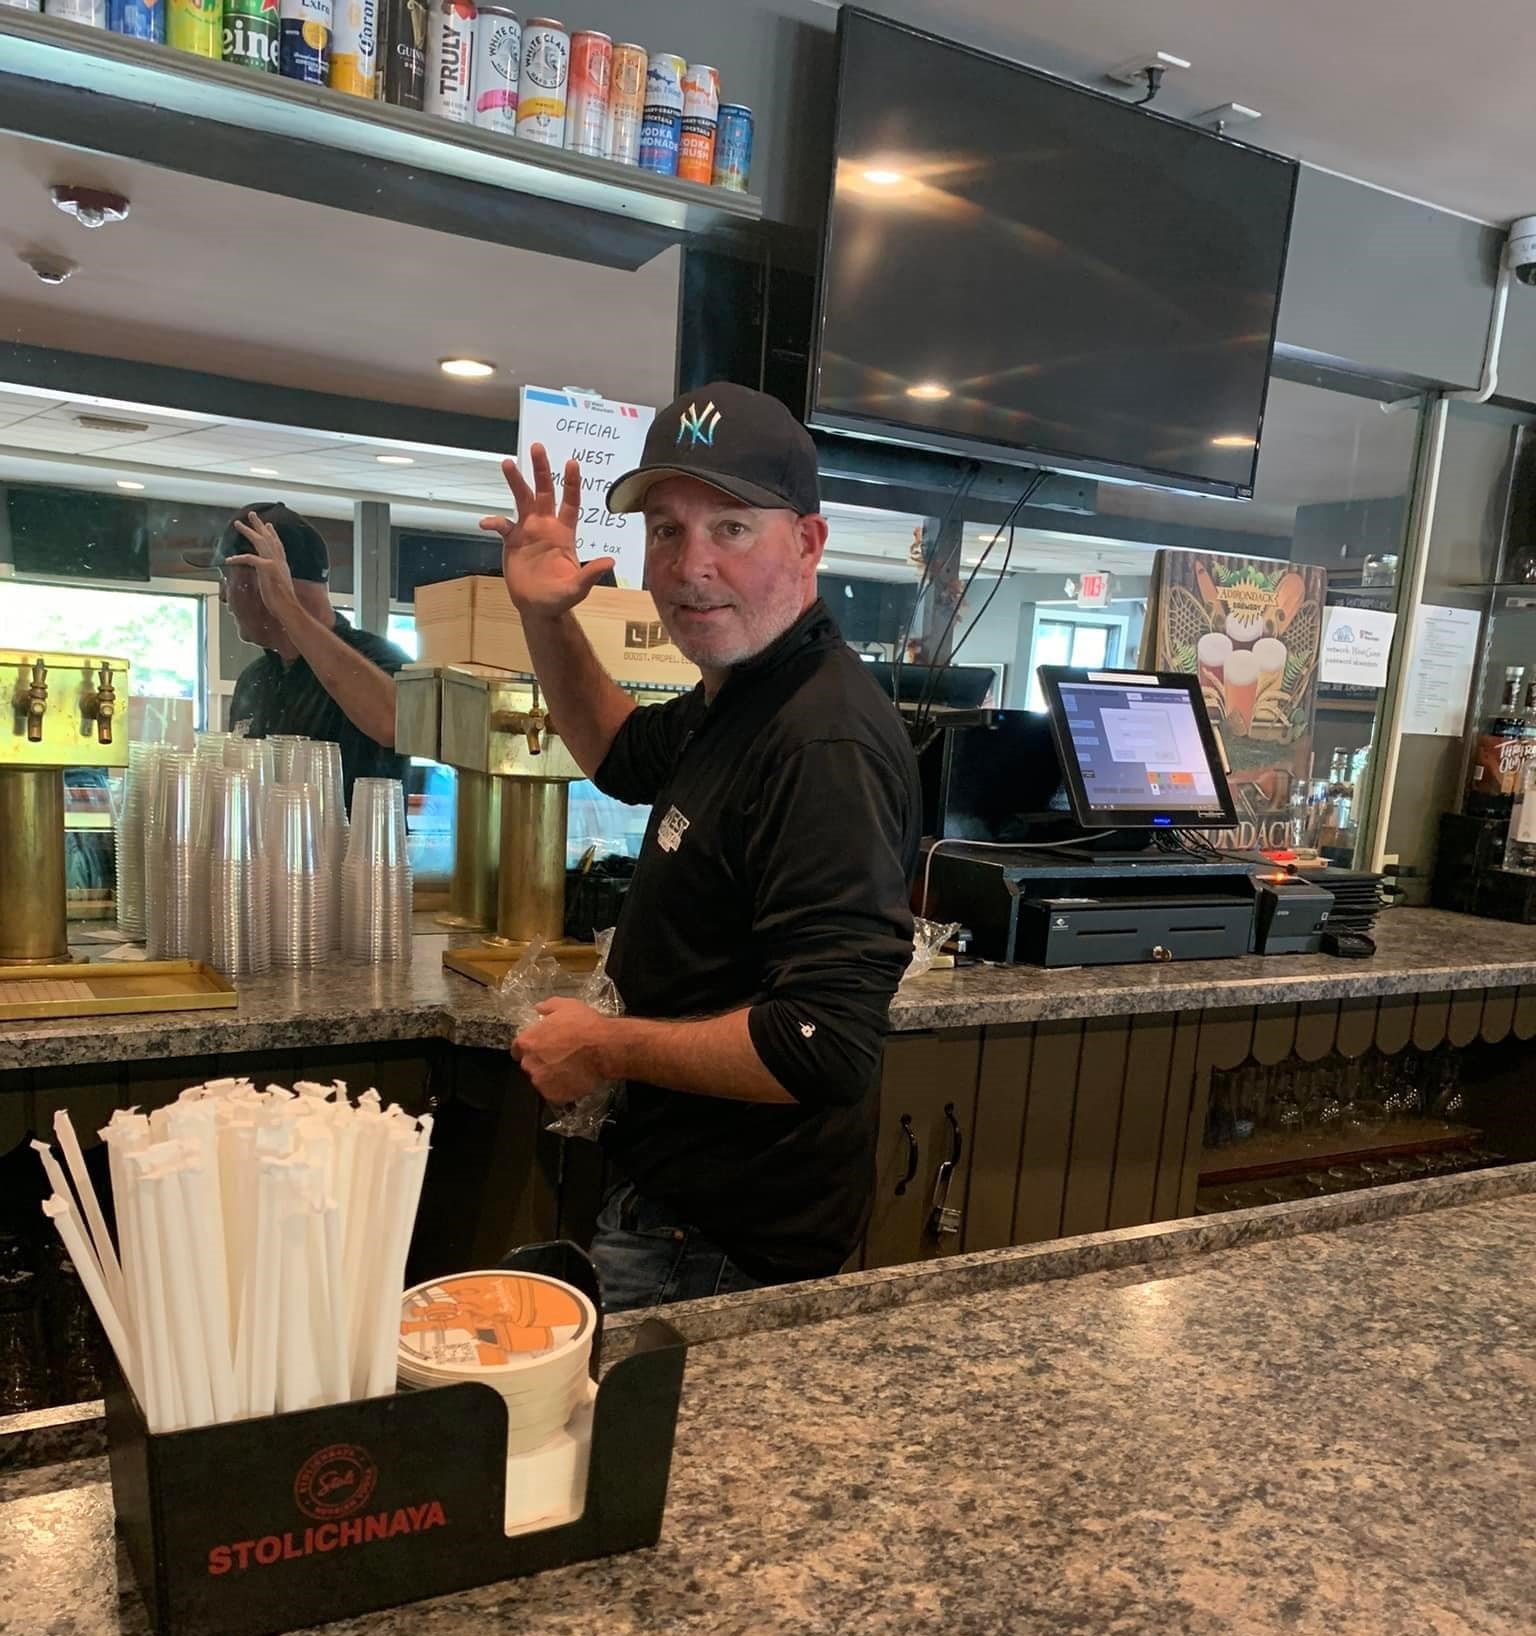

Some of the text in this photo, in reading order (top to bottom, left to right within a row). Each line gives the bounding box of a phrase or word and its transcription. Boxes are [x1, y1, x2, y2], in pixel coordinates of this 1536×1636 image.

[488, 26, 508, 57] WHITE
[525, 34, 566, 67] WHITE CLAW
[440, 24, 460, 95] TRULY
[556, 418, 621, 440] OFFICIAL
[676, 400, 722, 450] NY
[571, 448, 615, 465] WEST
[602, 541, 622, 554] tax
[1219, 589, 1275, 604] ADIRONDACK
[207, 1501, 447, 1575] STOLICHNAYA
